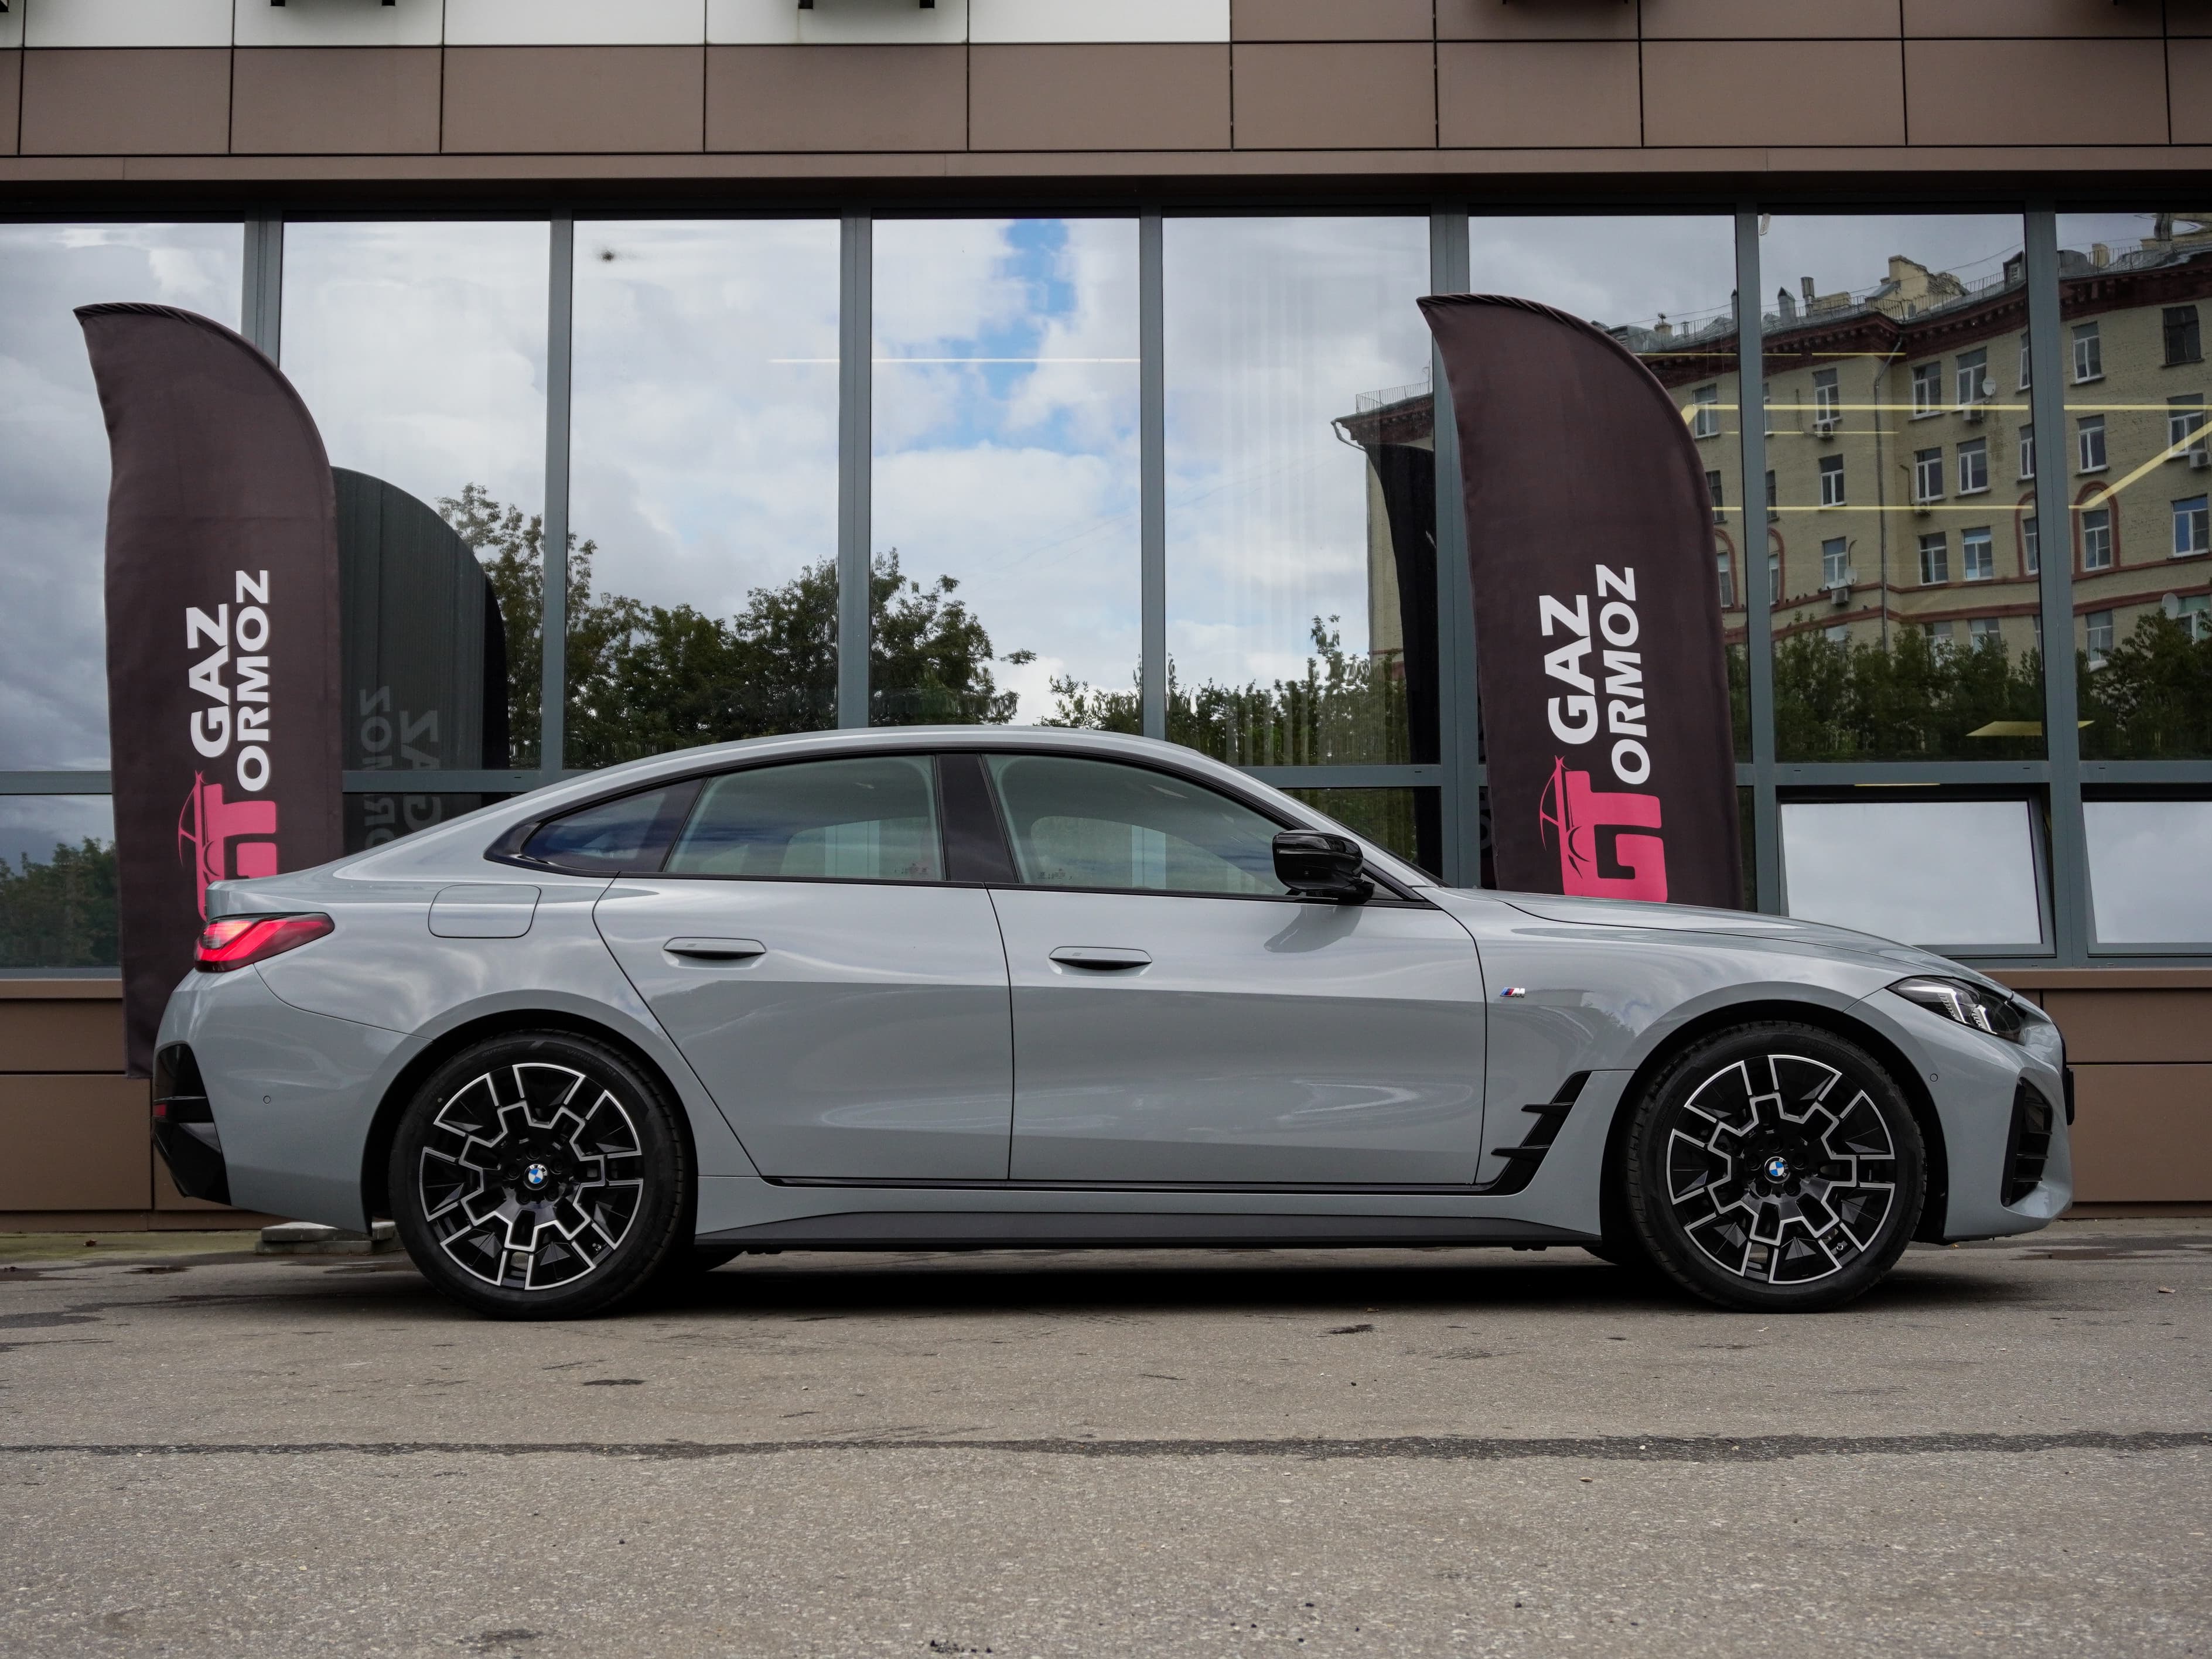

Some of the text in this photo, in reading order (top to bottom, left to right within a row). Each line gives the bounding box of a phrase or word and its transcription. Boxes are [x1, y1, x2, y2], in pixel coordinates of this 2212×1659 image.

[186, 603, 231, 757] GAZ
[235, 569, 269, 791] ORMOZ
[1539, 595, 1599, 745] GAZ
[1595, 564, 1651, 784] ORMOZ
